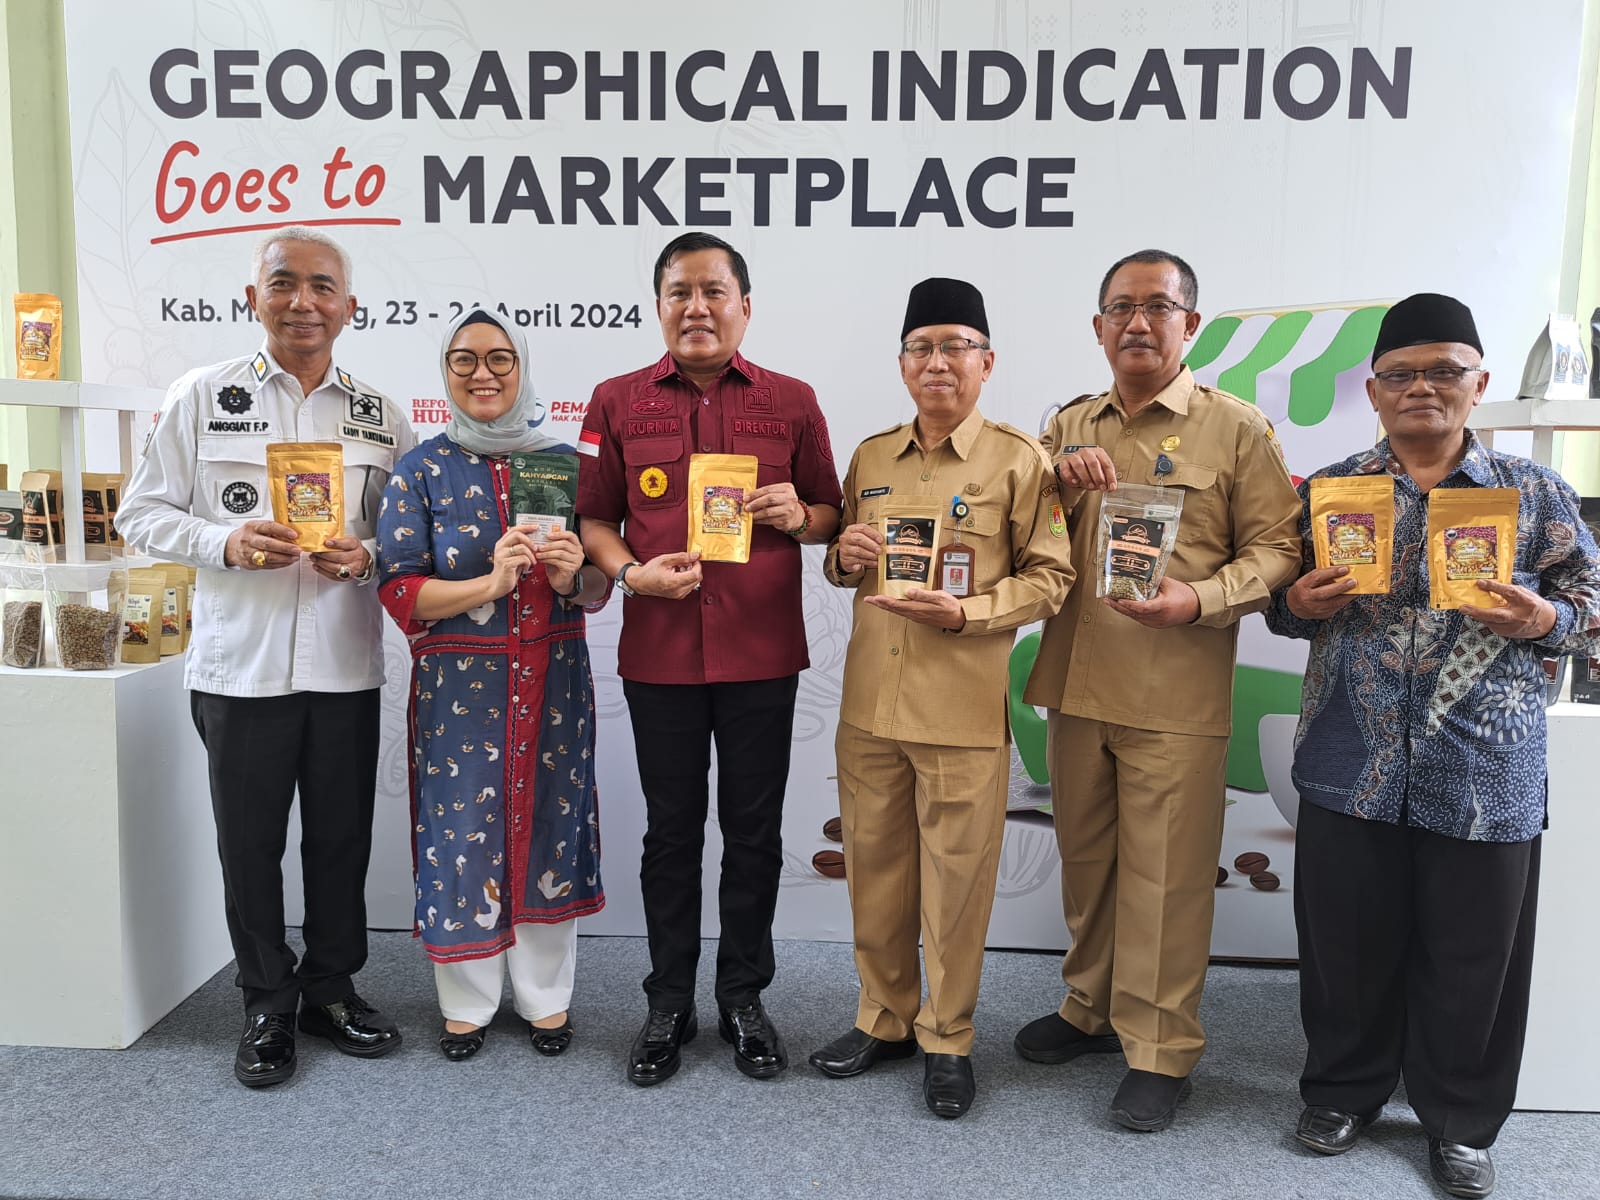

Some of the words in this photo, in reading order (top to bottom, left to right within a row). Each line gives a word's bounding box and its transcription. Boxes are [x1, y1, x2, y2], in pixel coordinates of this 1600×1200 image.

[149, 48, 847, 122] GEOGRAPHICAL
[871, 46, 1413, 121] INDICATION
[154, 140, 298, 225] Goes
[323, 146, 386, 208] to
[424, 155, 1075, 228] MARKETPLACE
[162, 298, 222, 322] Kab.
[386, 300, 418, 325] 23
[449, 301, 480, 324] 2
[570, 303, 642, 329] 2024
[412, 399, 449, 408] REFO
[552, 414, 570, 422] HAK
[208, 421, 251, 433] ANGGIAT
[253, 421, 269, 432] F.P
[628, 421, 679, 436] KURNIA
[734, 421, 786, 436] DIREKTUR
